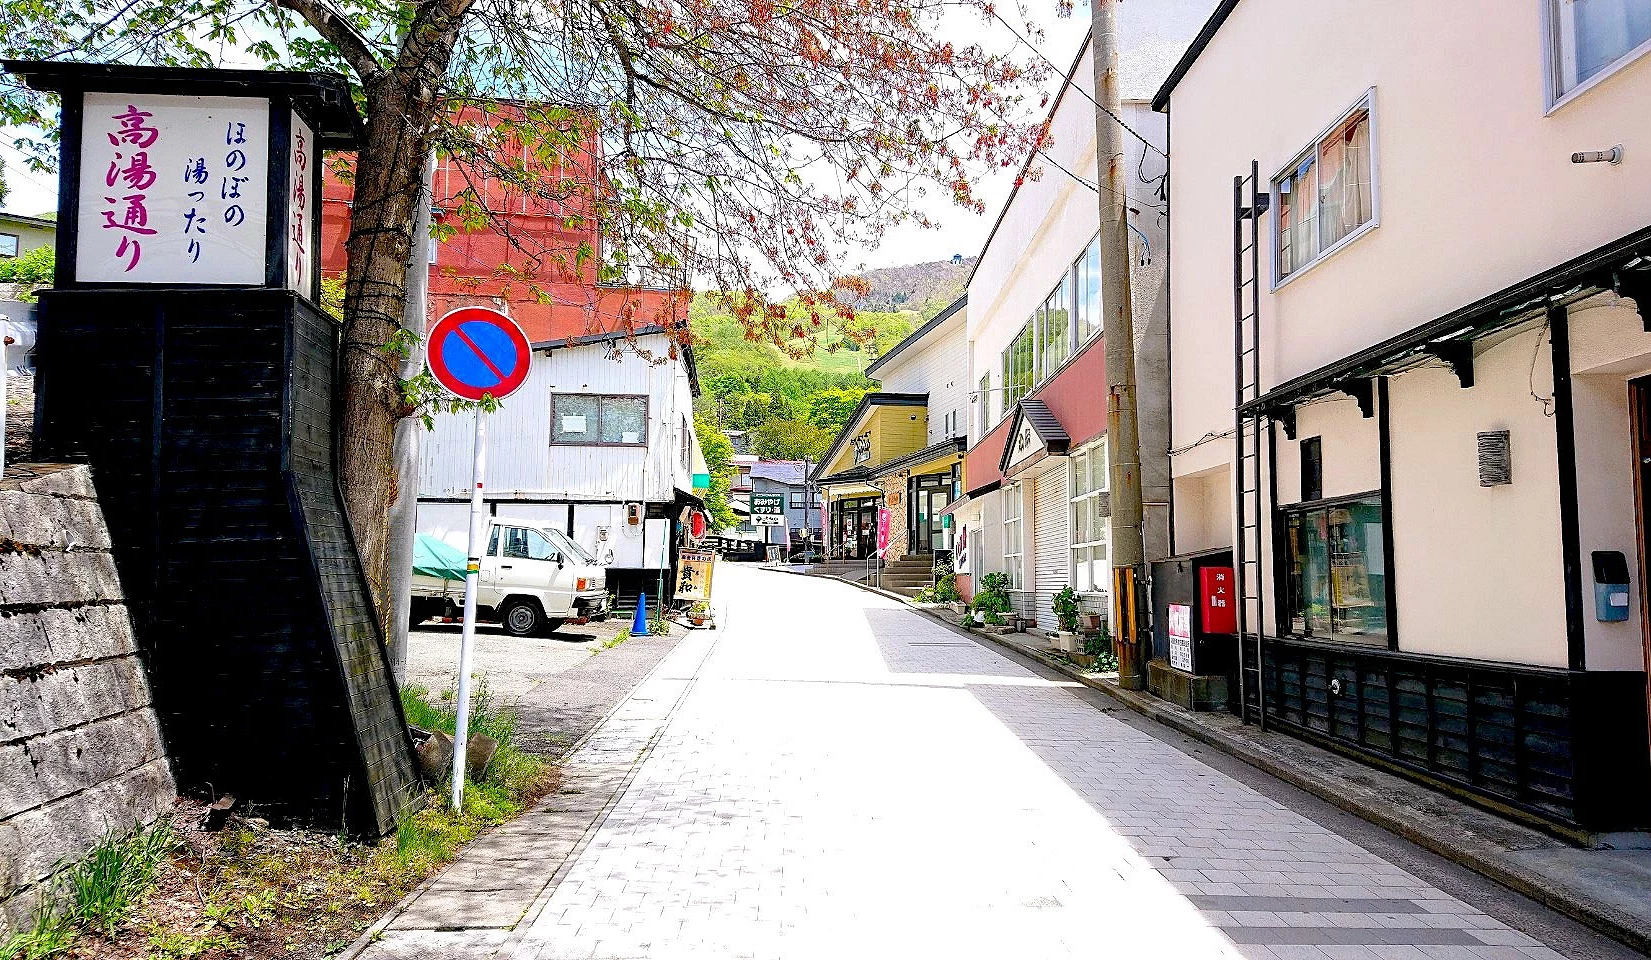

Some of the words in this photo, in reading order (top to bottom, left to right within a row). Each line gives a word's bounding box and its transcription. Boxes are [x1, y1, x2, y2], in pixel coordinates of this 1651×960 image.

[102, 104, 159, 273] 高湯通り
[183, 157, 209, 265] 湯ったり
[221, 120, 249, 228] ほのぼの
[291, 127, 307, 285] 高湯通り
[753, 498, 780, 506] おみやげ
[678, 565, 695, 593] 貴和
[1216, 573, 1226, 608] 消火器
